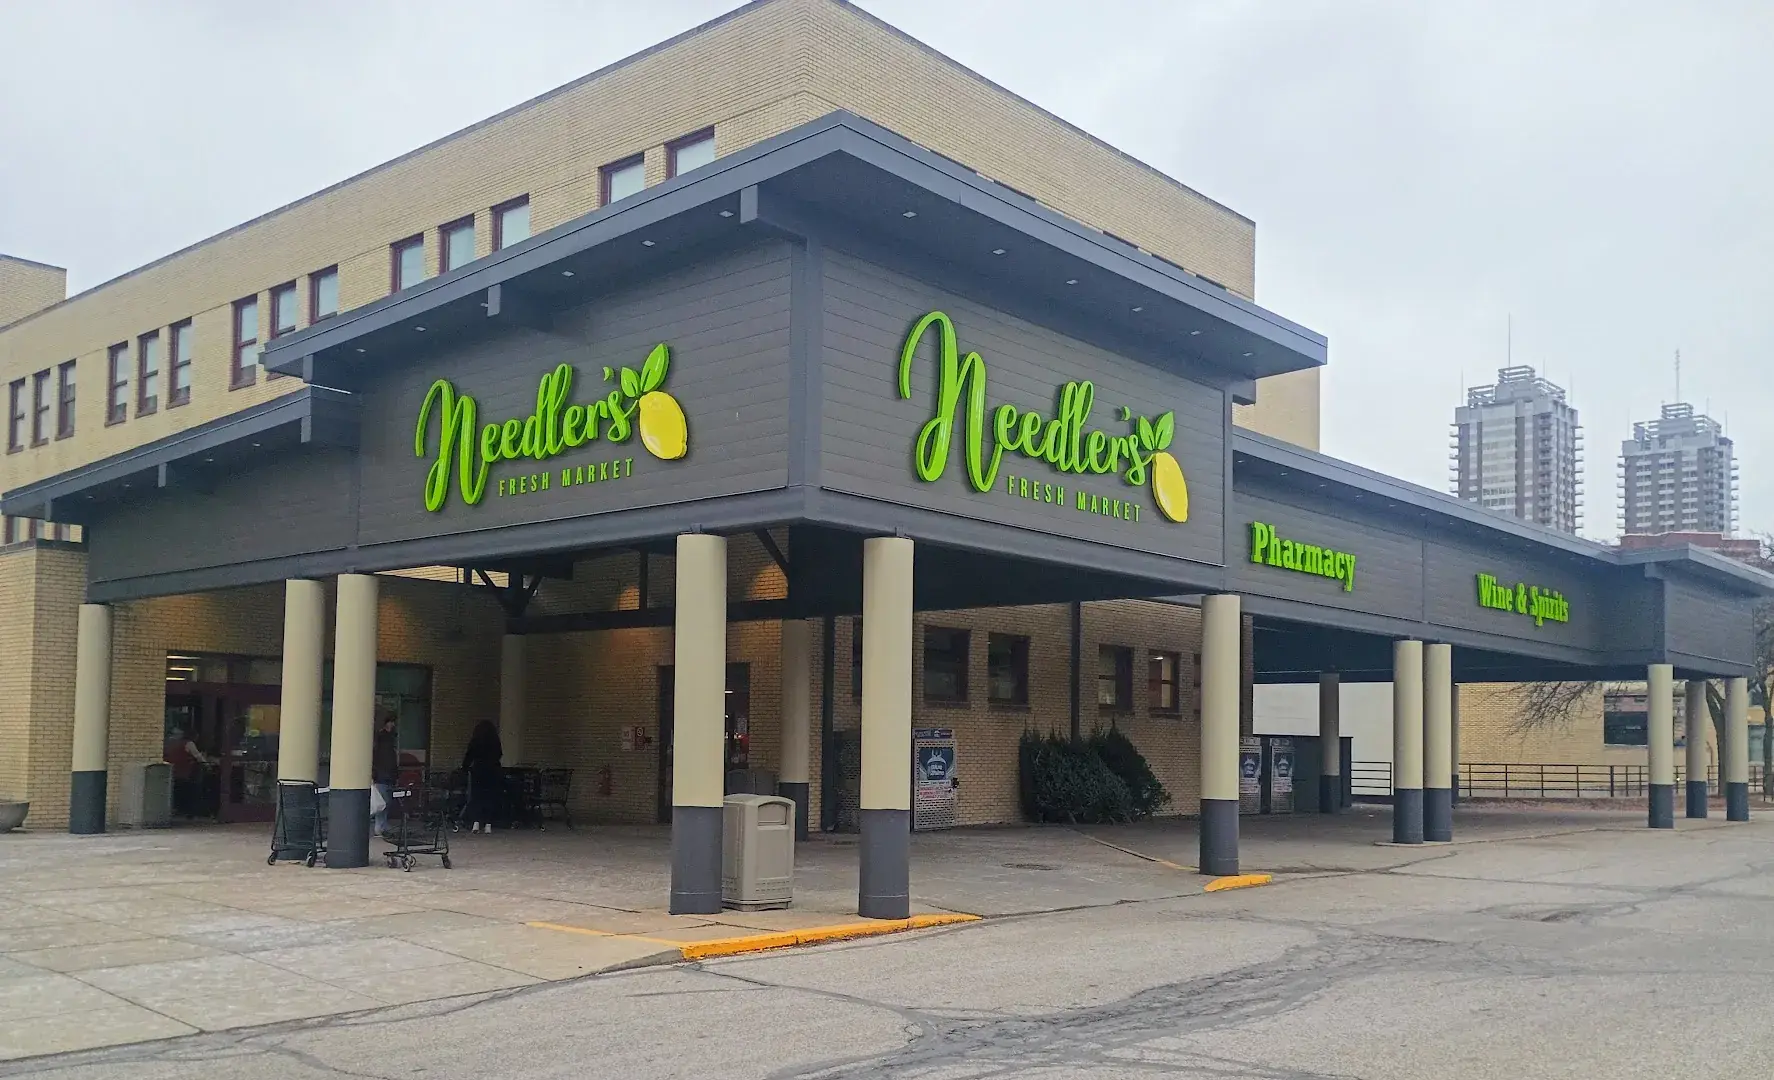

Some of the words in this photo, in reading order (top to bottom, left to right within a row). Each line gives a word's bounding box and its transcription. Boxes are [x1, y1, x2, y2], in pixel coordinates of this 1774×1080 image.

[899, 311, 1152, 493] Needler's
[414, 363, 638, 512] Needler's
[499, 472, 550, 497] FRESH
[562, 457, 634, 488] MARKET
[1007, 475, 1065, 506] FRESH
[1076, 491, 1142, 523] MARKET
[1251, 521, 1356, 592] Pharmacy
[1477, 573, 1513, 613] Wine
[1515, 582, 1528, 615] &
[1530, 586, 1569, 627] Spirits
